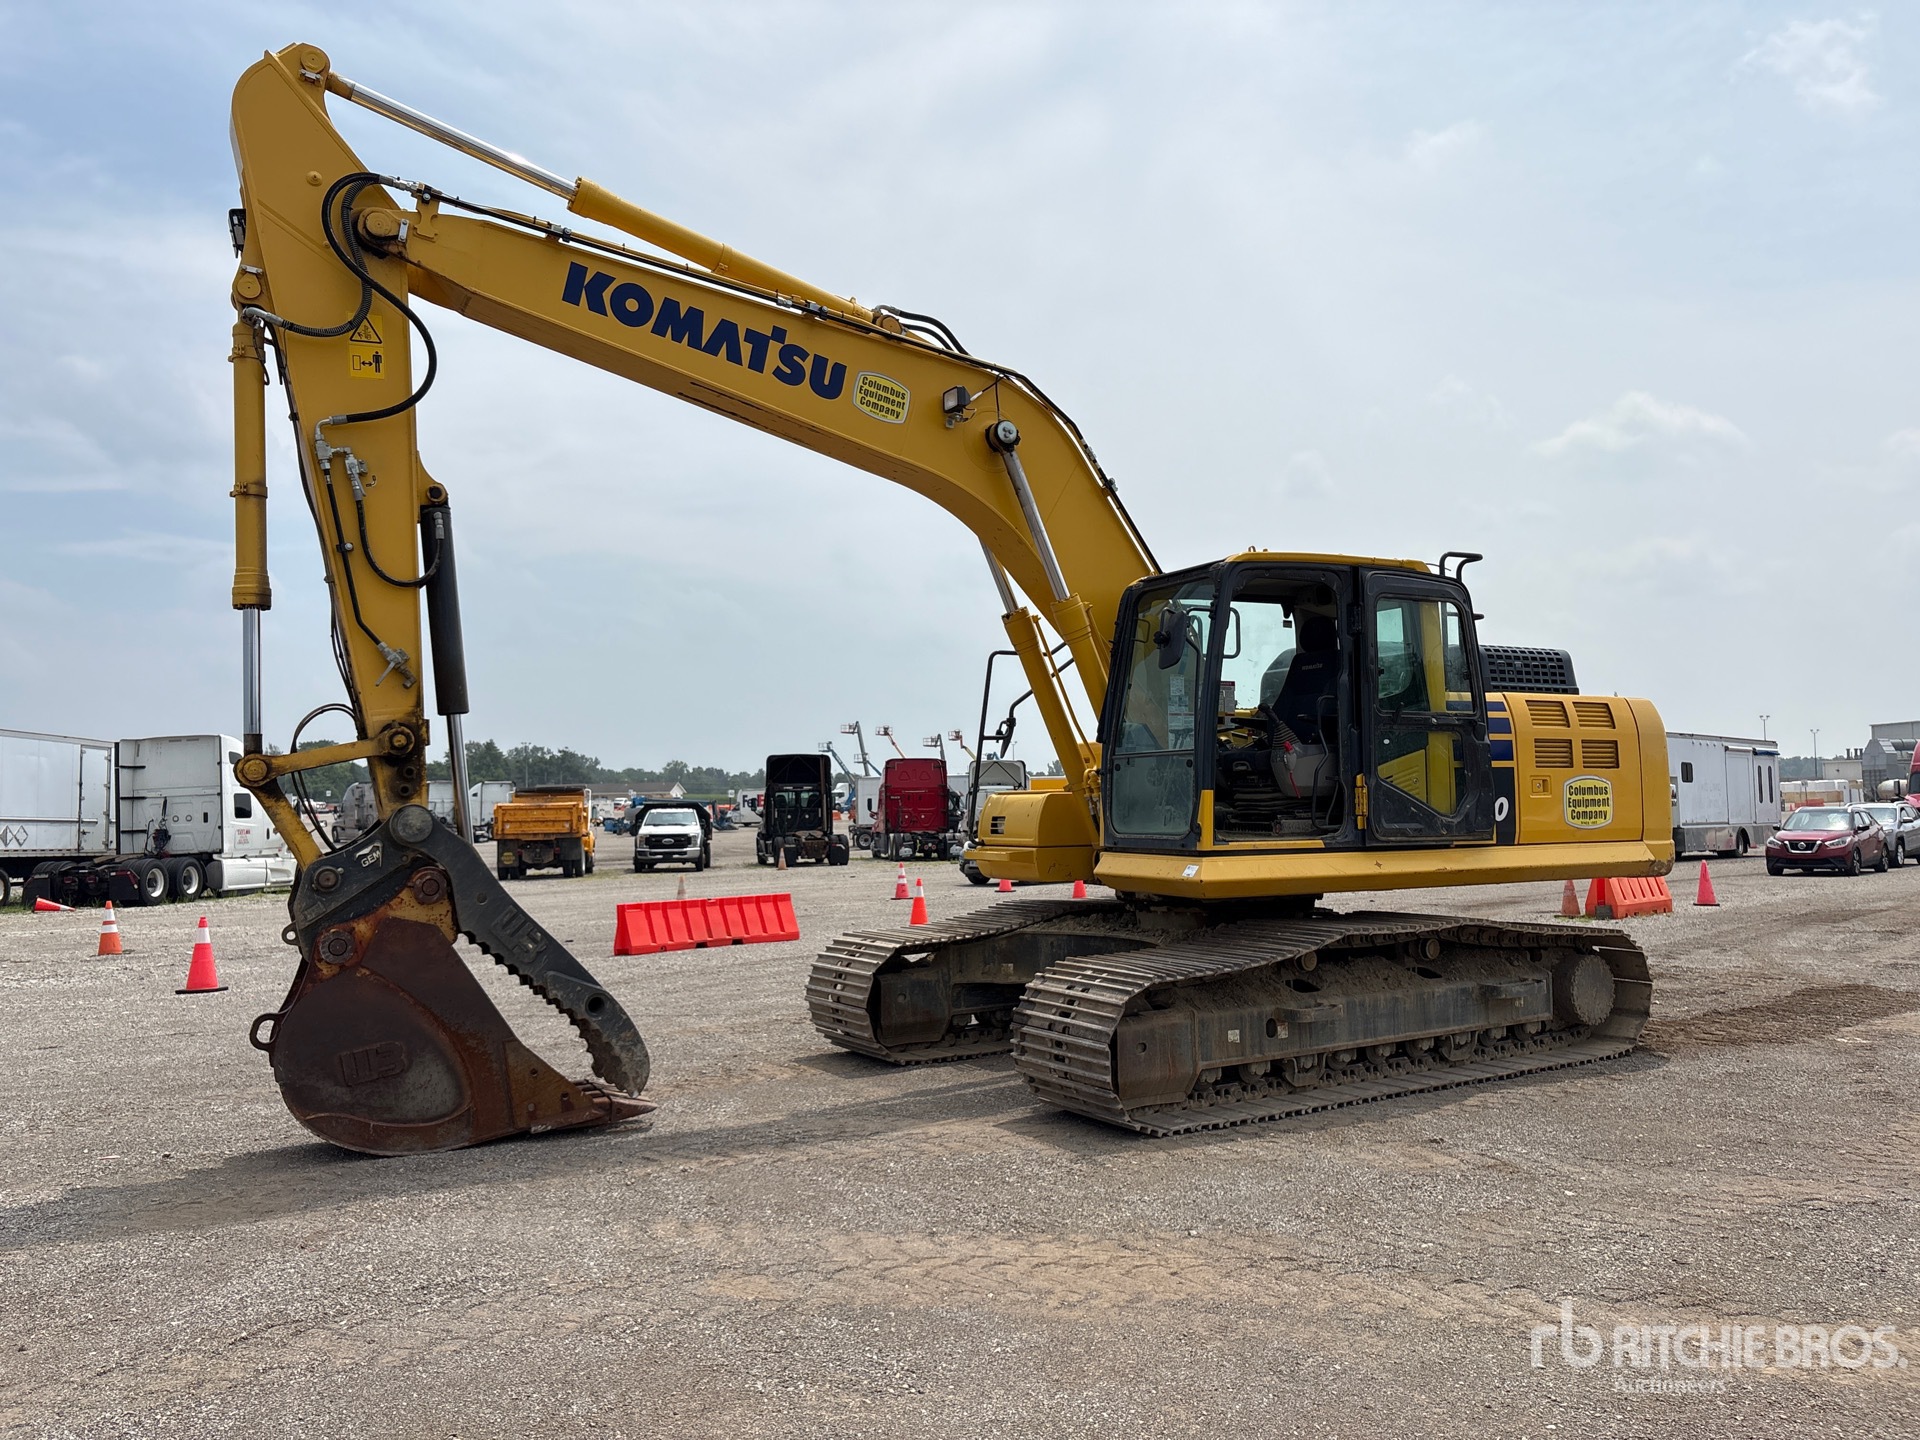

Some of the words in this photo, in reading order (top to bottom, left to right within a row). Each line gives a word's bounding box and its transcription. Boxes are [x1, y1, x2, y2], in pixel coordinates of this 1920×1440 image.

[562, 261, 848, 400] KOMATSU
[858, 385, 906, 411] Equipment
[862, 376, 906, 400] Columbus
[859, 396, 901, 419] Company
[1568, 784, 1609, 796] Columbus
[1567, 796, 1610, 809] Equipment
[1570, 809, 1608, 820] Company
[361, 850, 381, 867] GEM
